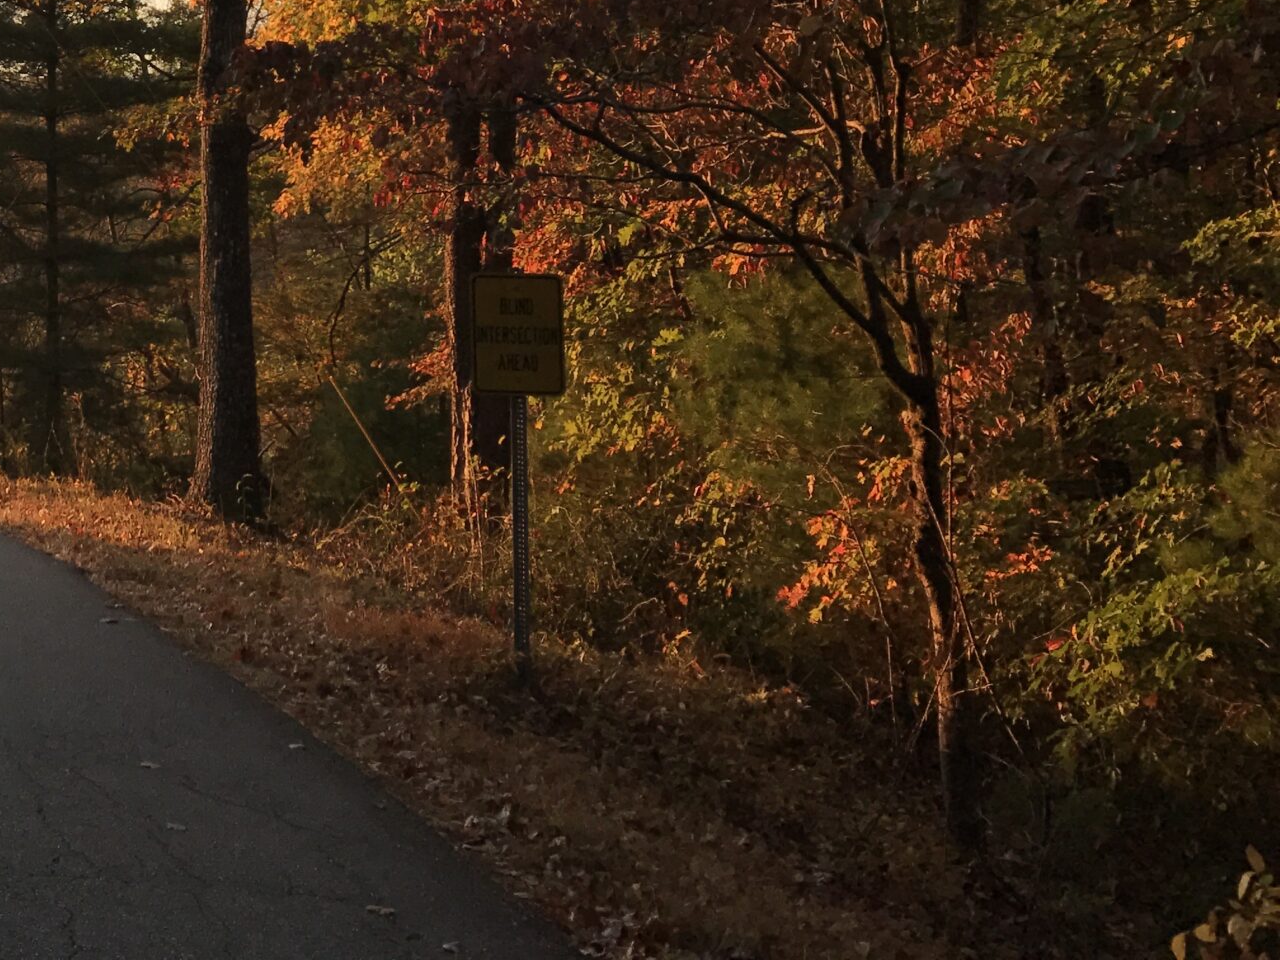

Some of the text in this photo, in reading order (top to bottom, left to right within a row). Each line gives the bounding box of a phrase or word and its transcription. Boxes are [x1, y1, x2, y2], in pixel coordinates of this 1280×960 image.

[500, 297, 533, 315] BLIND
[477, 327, 558, 345] INTERSECTION
[498, 354, 538, 372] AHEAD
